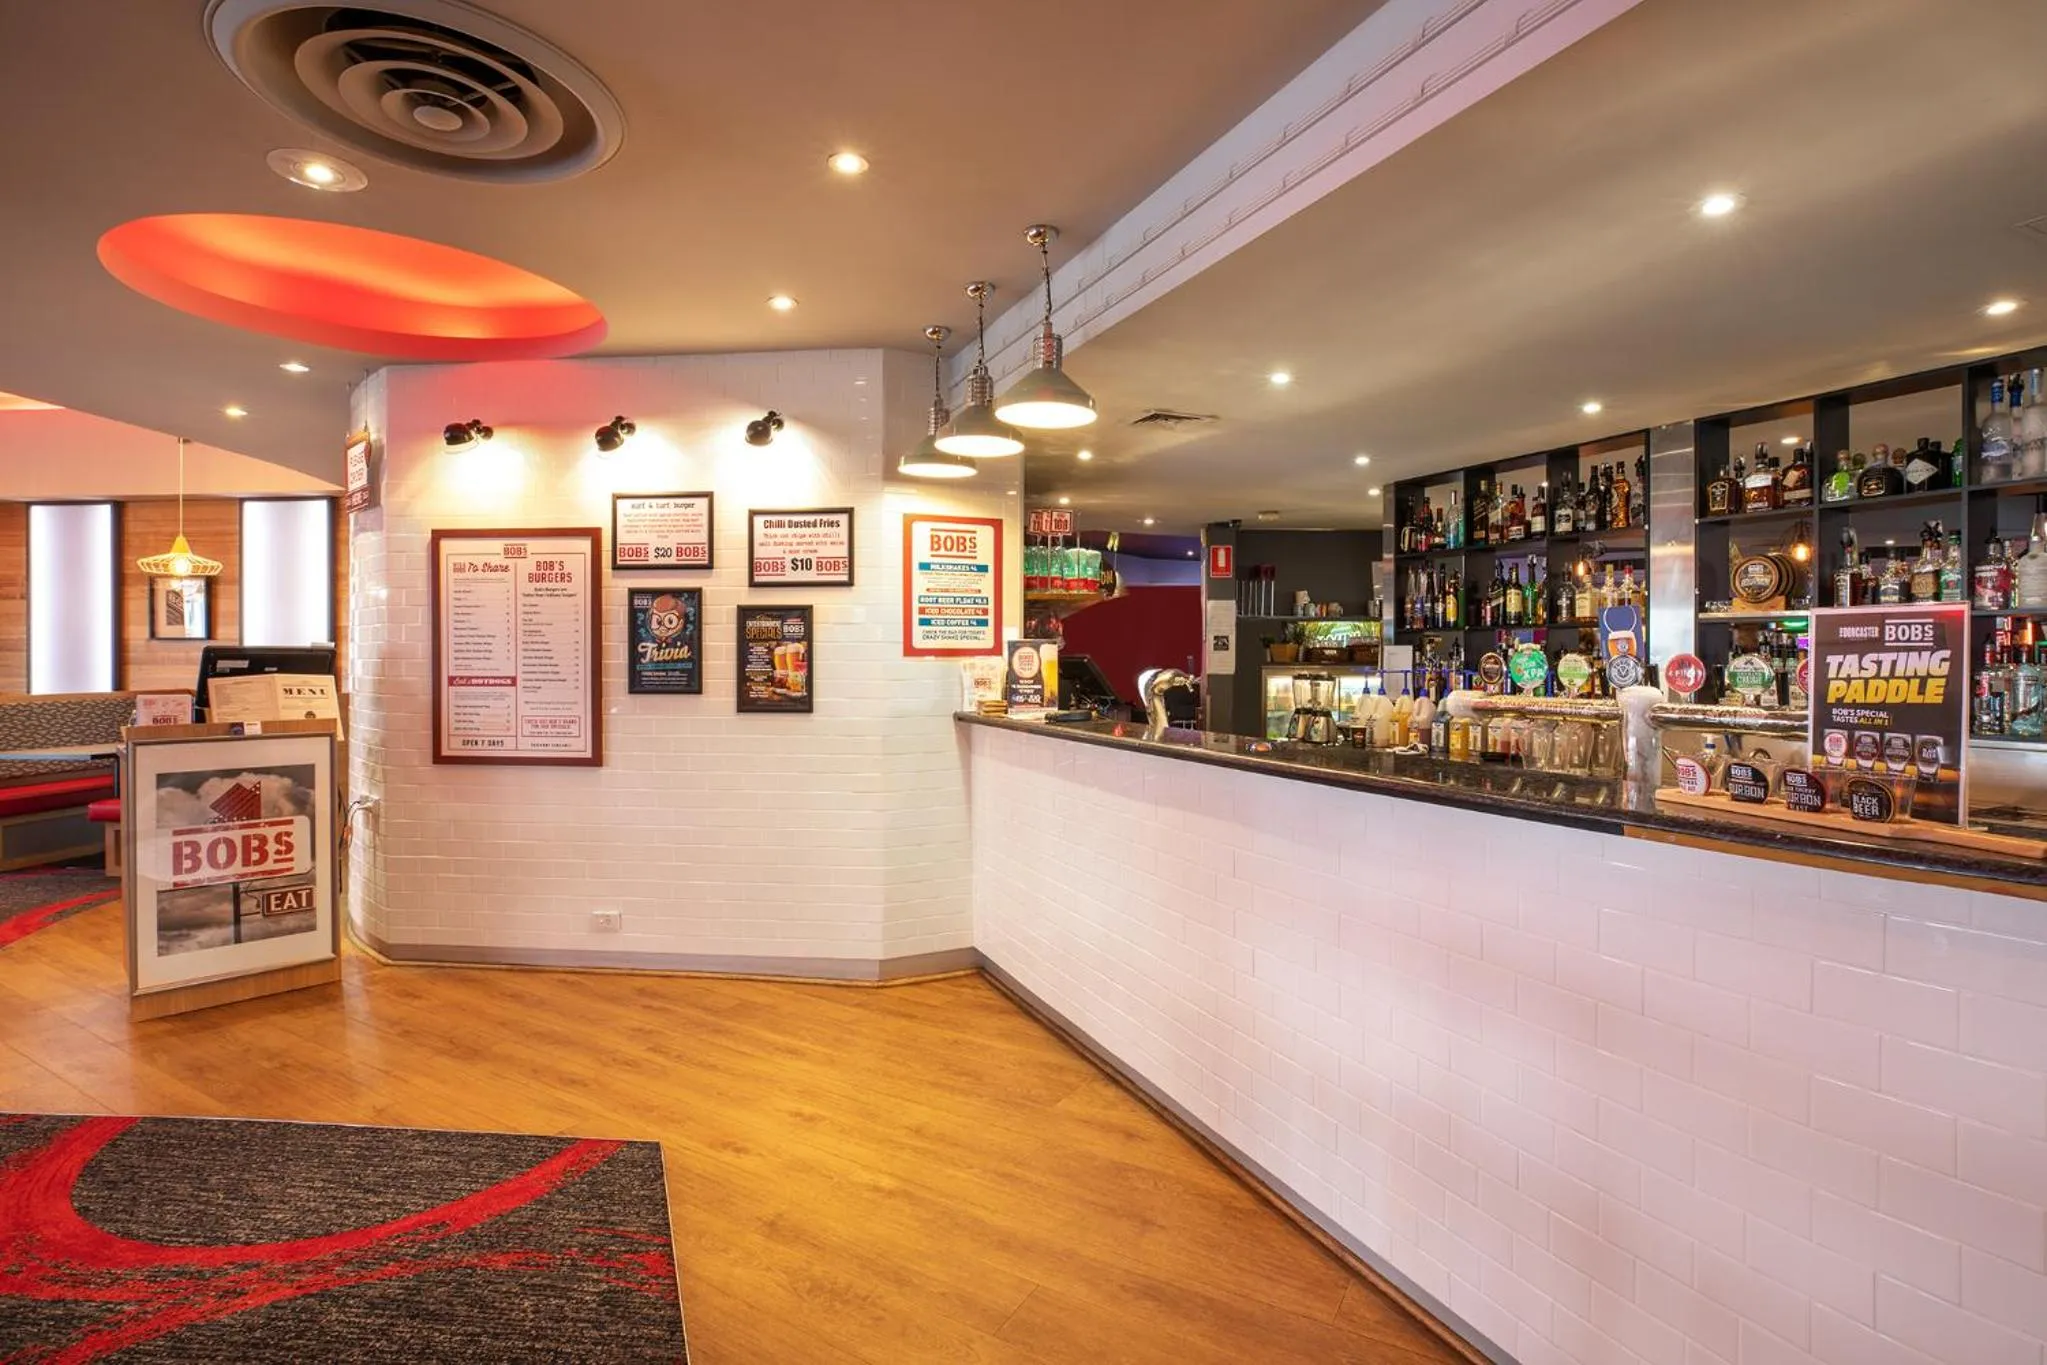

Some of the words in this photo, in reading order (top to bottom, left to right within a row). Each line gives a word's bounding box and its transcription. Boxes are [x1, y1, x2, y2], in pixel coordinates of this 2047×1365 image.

[673, 502, 695, 510] burger
[764, 520, 786, 528] Chilli
[788, 518, 818, 528] Dusted
[819, 518, 840, 528] Fries
[654, 546, 672, 559] $20
[481, 562, 510, 573] Share
[536, 560, 564, 572] BOB'S
[791, 557, 812, 572] $10
[528, 572, 572, 584] BURGERS
[746, 626, 782, 640] SPECIALS
[1884, 624, 1934, 640] BOBS
[637, 641, 692, 663] Trivia
[1826, 650, 1952, 678] TASTING
[1827, 678, 1947, 704] PADDLE
[1832, 708, 1855, 716] BOB'S
[1856, 709, 1889, 718] SPECIAL
[1832, 714, 1858, 724] TASTES
[462, 739, 478, 747] OPEN
[488, 739, 504, 747] DAYS
[1852, 794, 1878, 805] BLACK
[1852, 802, 1880, 816] BEER
[172, 830, 294, 876] BOBS
[270, 889, 311, 912] EAT
